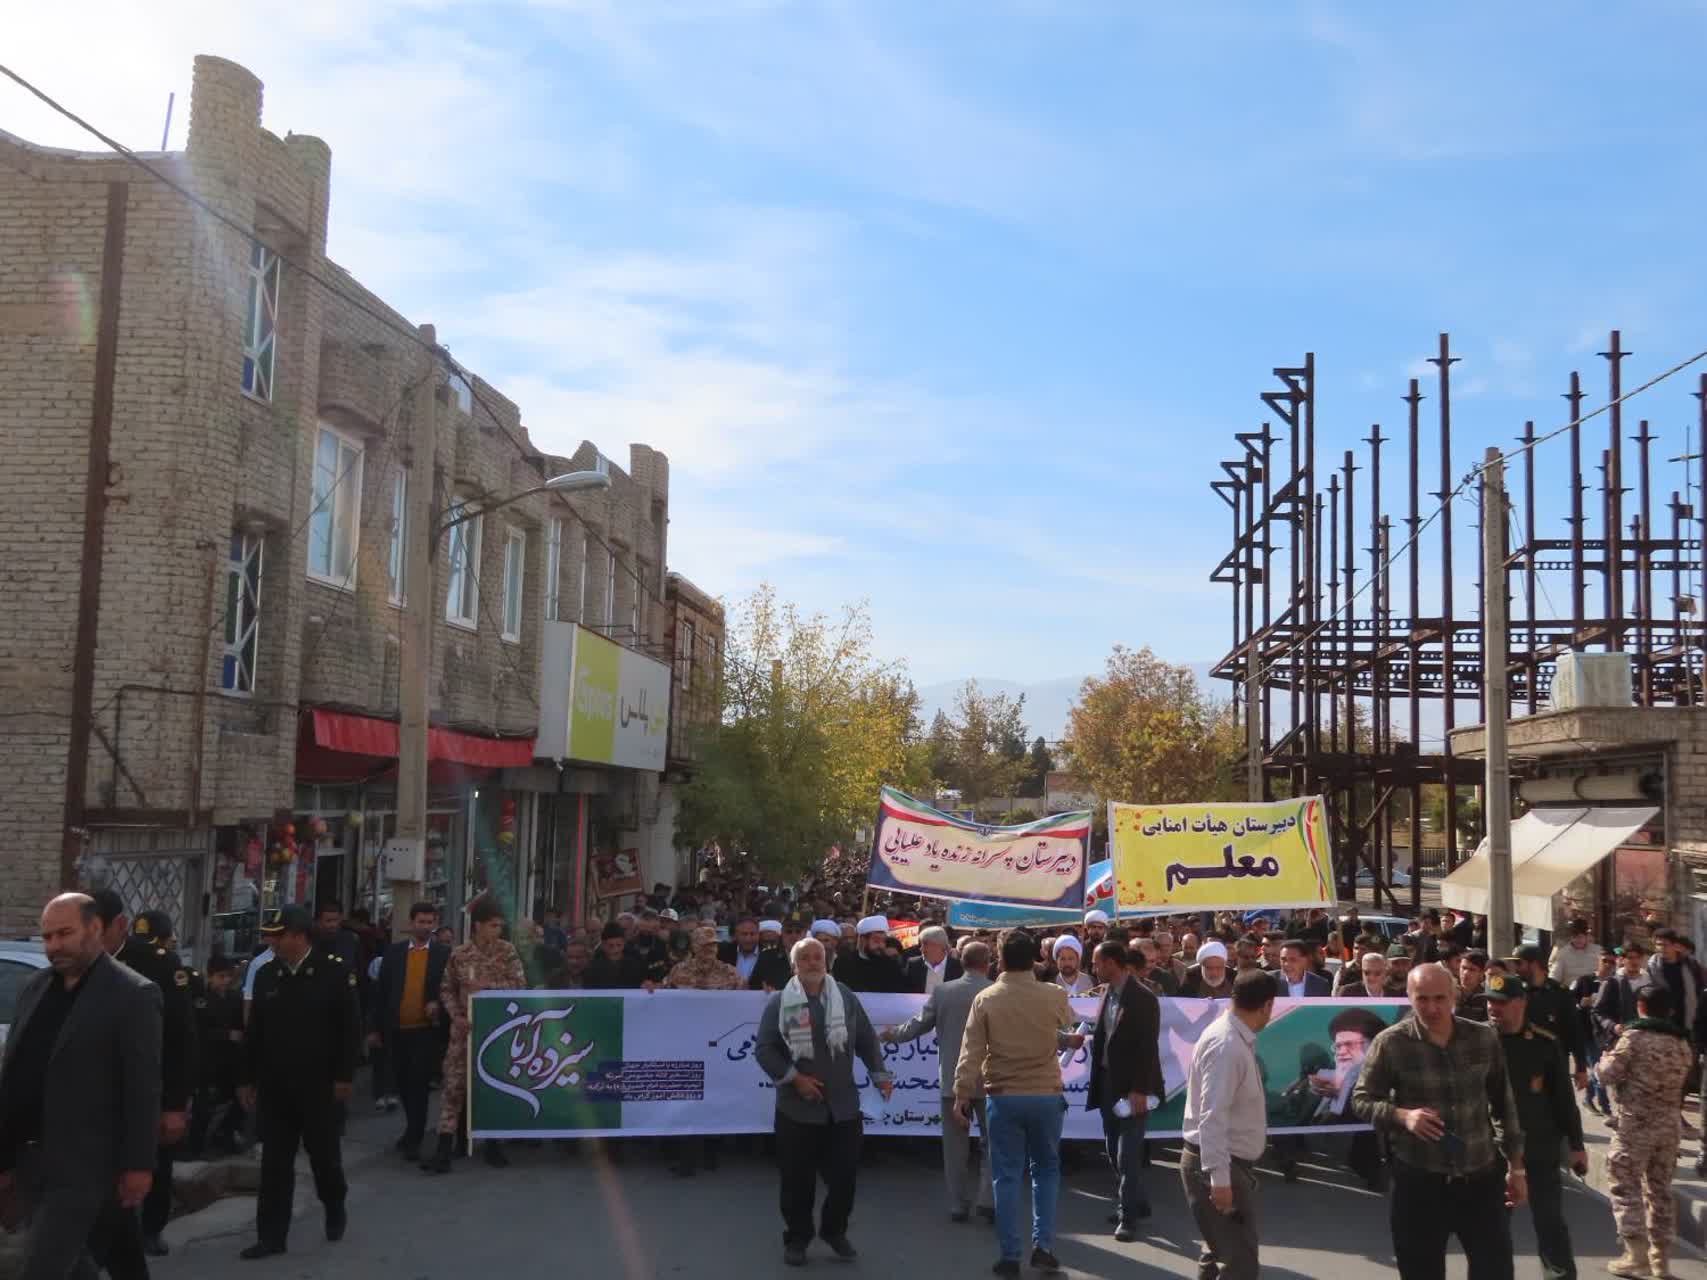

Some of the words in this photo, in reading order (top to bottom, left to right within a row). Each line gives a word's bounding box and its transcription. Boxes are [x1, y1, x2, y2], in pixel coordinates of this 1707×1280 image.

[1142, 816, 1187, 836] امنایی
[1191, 813, 1228, 836] هیأت
[1232, 815, 1297, 836] دبیرستان
[925, 839, 941, 871] یاد
[941, 845, 970, 863] زنده
[972, 846, 1015, 868] پسرانه
[1016, 842, 1077, 874] دبیرستان
[1165, 844, 1280, 892] معلم
[477, 1001, 576, 1119] آبان
[528, 1031, 594, 1091] سیزده
[892, 1110, 944, 1126] هرستان
